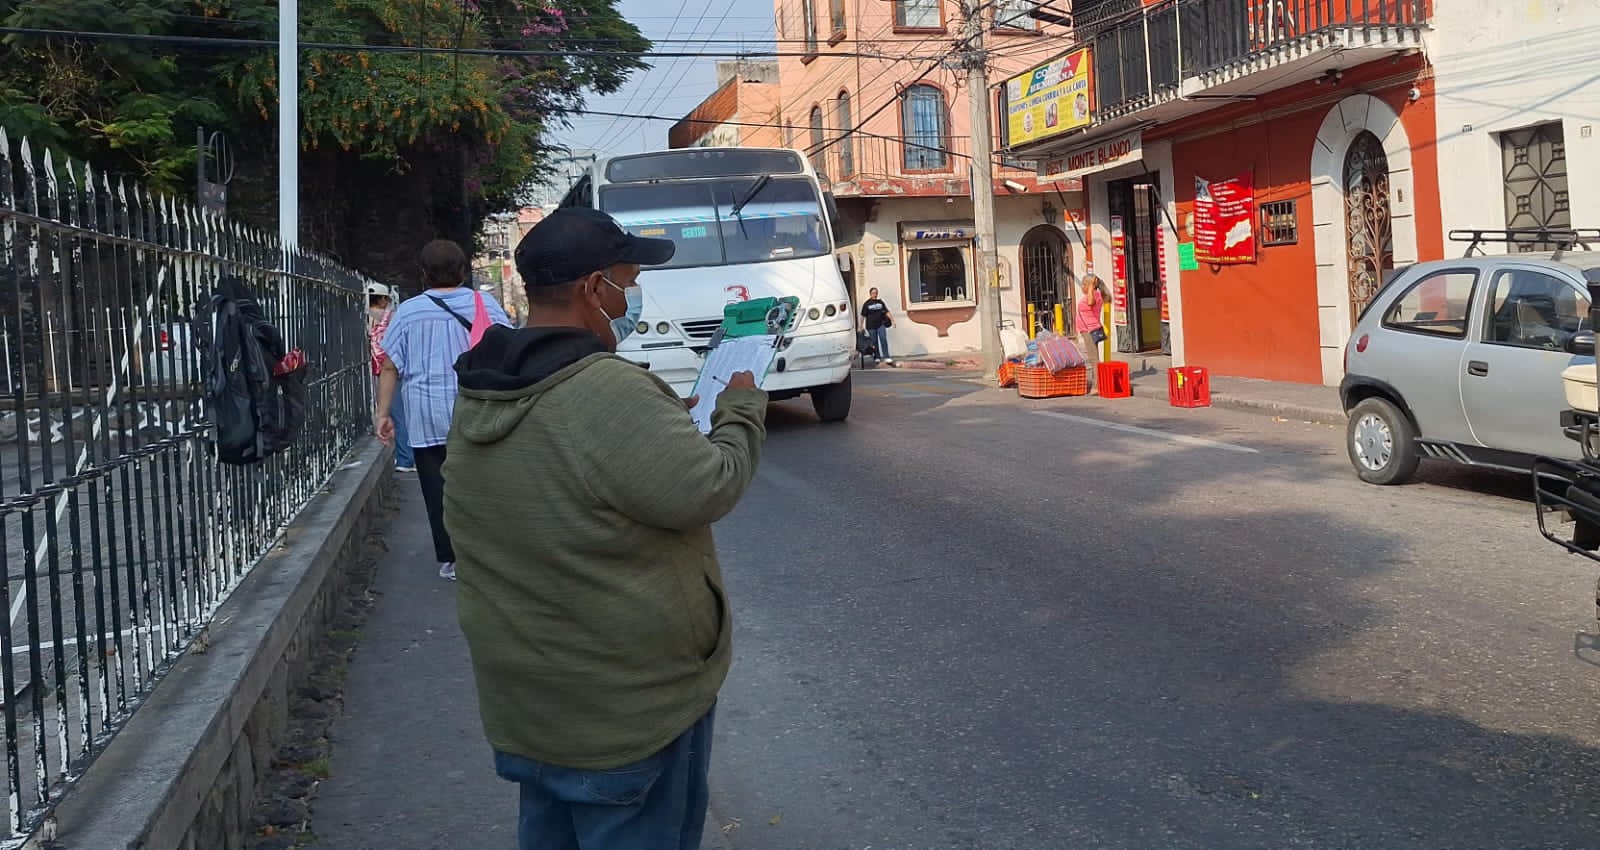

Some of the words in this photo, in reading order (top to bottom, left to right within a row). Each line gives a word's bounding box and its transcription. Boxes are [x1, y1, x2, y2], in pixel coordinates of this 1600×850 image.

[1068, 151, 1095, 172] MONTE
[1098, 138, 1131, 163] BLANCO
[681, 226, 707, 239] CENTRO
[724, 284, 751, 304] 3
